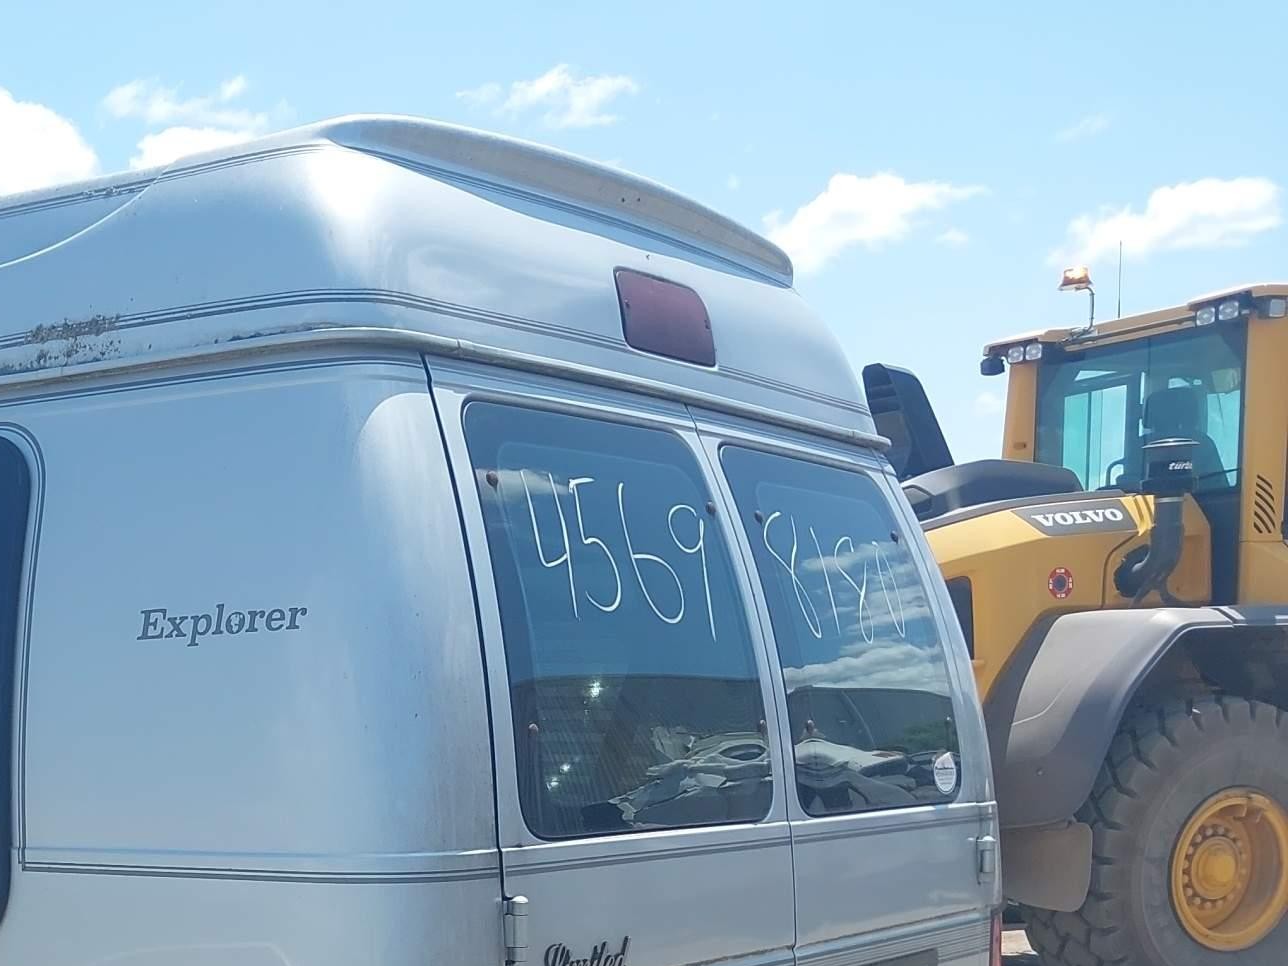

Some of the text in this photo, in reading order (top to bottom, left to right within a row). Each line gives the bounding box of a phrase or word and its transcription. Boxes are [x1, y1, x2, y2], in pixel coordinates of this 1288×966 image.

[1031, 507, 1124, 527] VOLVO
[520, 469, 718, 642] 4569
[136, 603, 308, 647] Explorer
